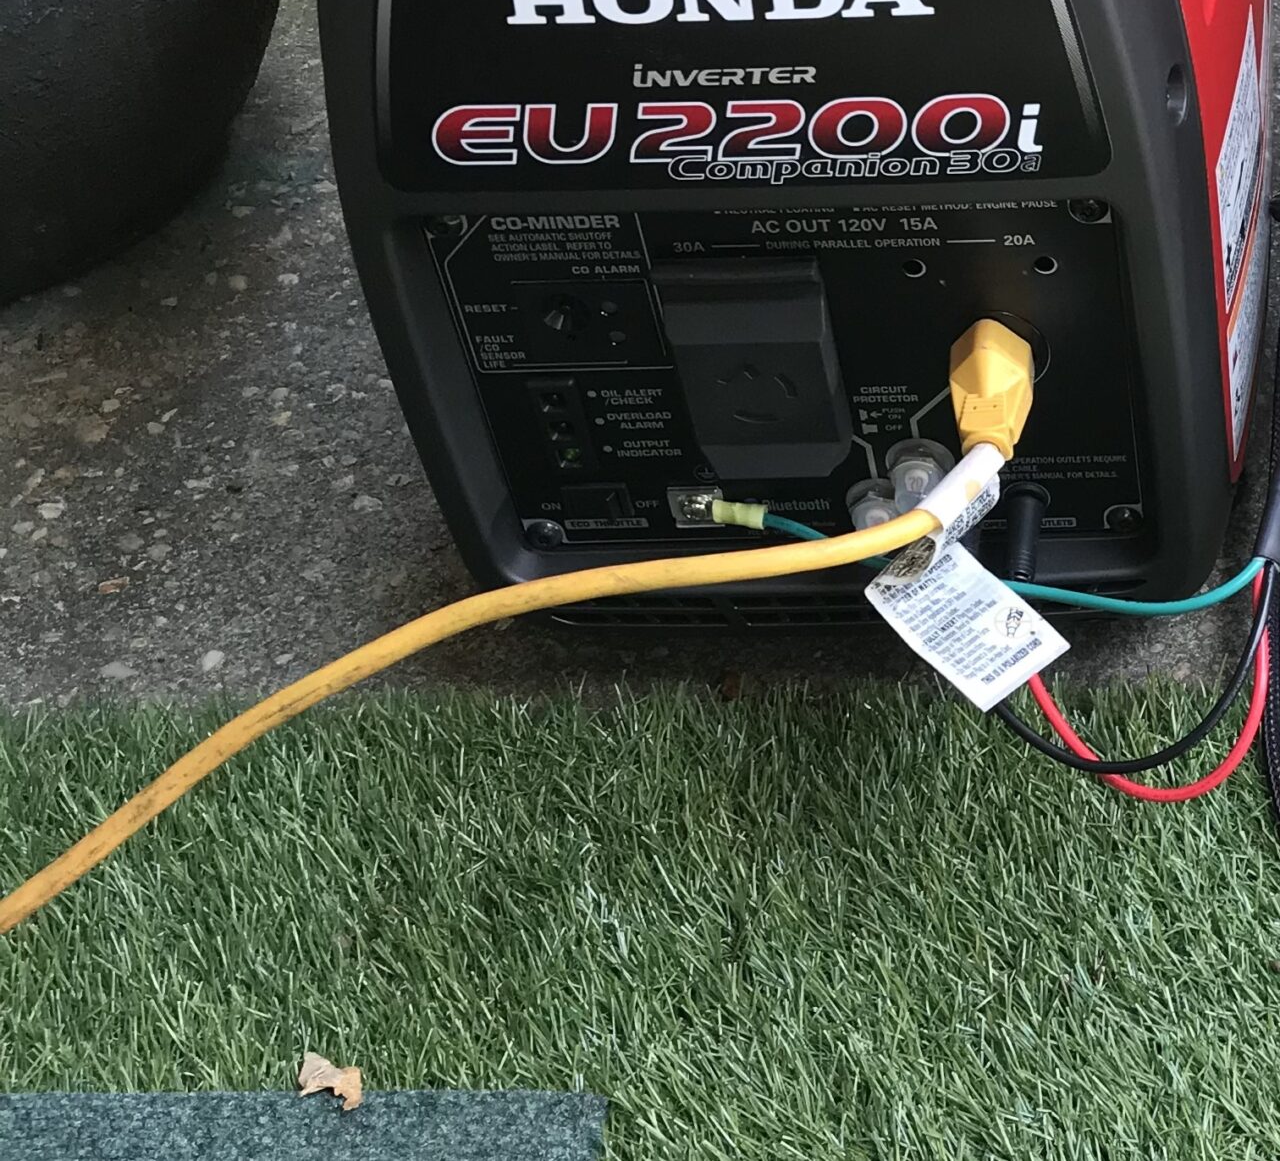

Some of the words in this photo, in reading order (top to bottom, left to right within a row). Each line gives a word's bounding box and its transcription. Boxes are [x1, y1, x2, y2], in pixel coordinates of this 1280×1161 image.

[669, 152, 940, 185] Companion
[1021, 199, 1058, 208] PAUSE
[490, 214, 621, 231] CO-MINDER
[751, 218, 781, 235] AC
[785, 218, 831, 234] OUT
[837, 217, 887, 233] 120V
[900, 216, 939, 231] 15A
[508, 232, 567, 243] AUTOMATIC
[568, 231, 613, 241] SHUTOFF
[491, 242, 528, 253] ACTION
[566, 241, 596, 251] REFER
[597, 240, 612, 250] TO
[673, 241, 705, 253] 30A
[766, 240, 811, 250] DURING
[813, 239, 873, 249] PARALLEL
[874, 237, 940, 249] OPERATION
[1003, 234, 1036, 247] 20A
[493, 253, 538, 262] OWNER'S
[539, 252, 581, 261] MANUAL
[581, 251, 600, 261] FOR
[571, 265, 590, 274] CO
[594, 264, 641, 274] ALARM
[464, 304, 508, 313] RESET
[475, 334, 515, 344] FAULT
[480, 351, 526, 360] SENSOR
[483, 360, 507, 368] LIFE
[600, 389, 621, 398] OIL
[625, 388, 663, 397] ALERT
[860, 385, 908, 394] CIRCUIT
[605, 397, 655, 406] /CHECK
[852, 394, 919, 403] PROTECTOR
[606, 411, 672, 420] OVERLOAD
[620, 421, 665, 429] ALARM
[623, 440, 670, 448] OUTPUT
[616, 448, 682, 458] INDICATOR
[541, 502, 562, 511] ON
[635, 500, 660, 509] OFF
[570, 520, 590, 528] ECO
[1041, 519, 1074, 528] UTLETS
